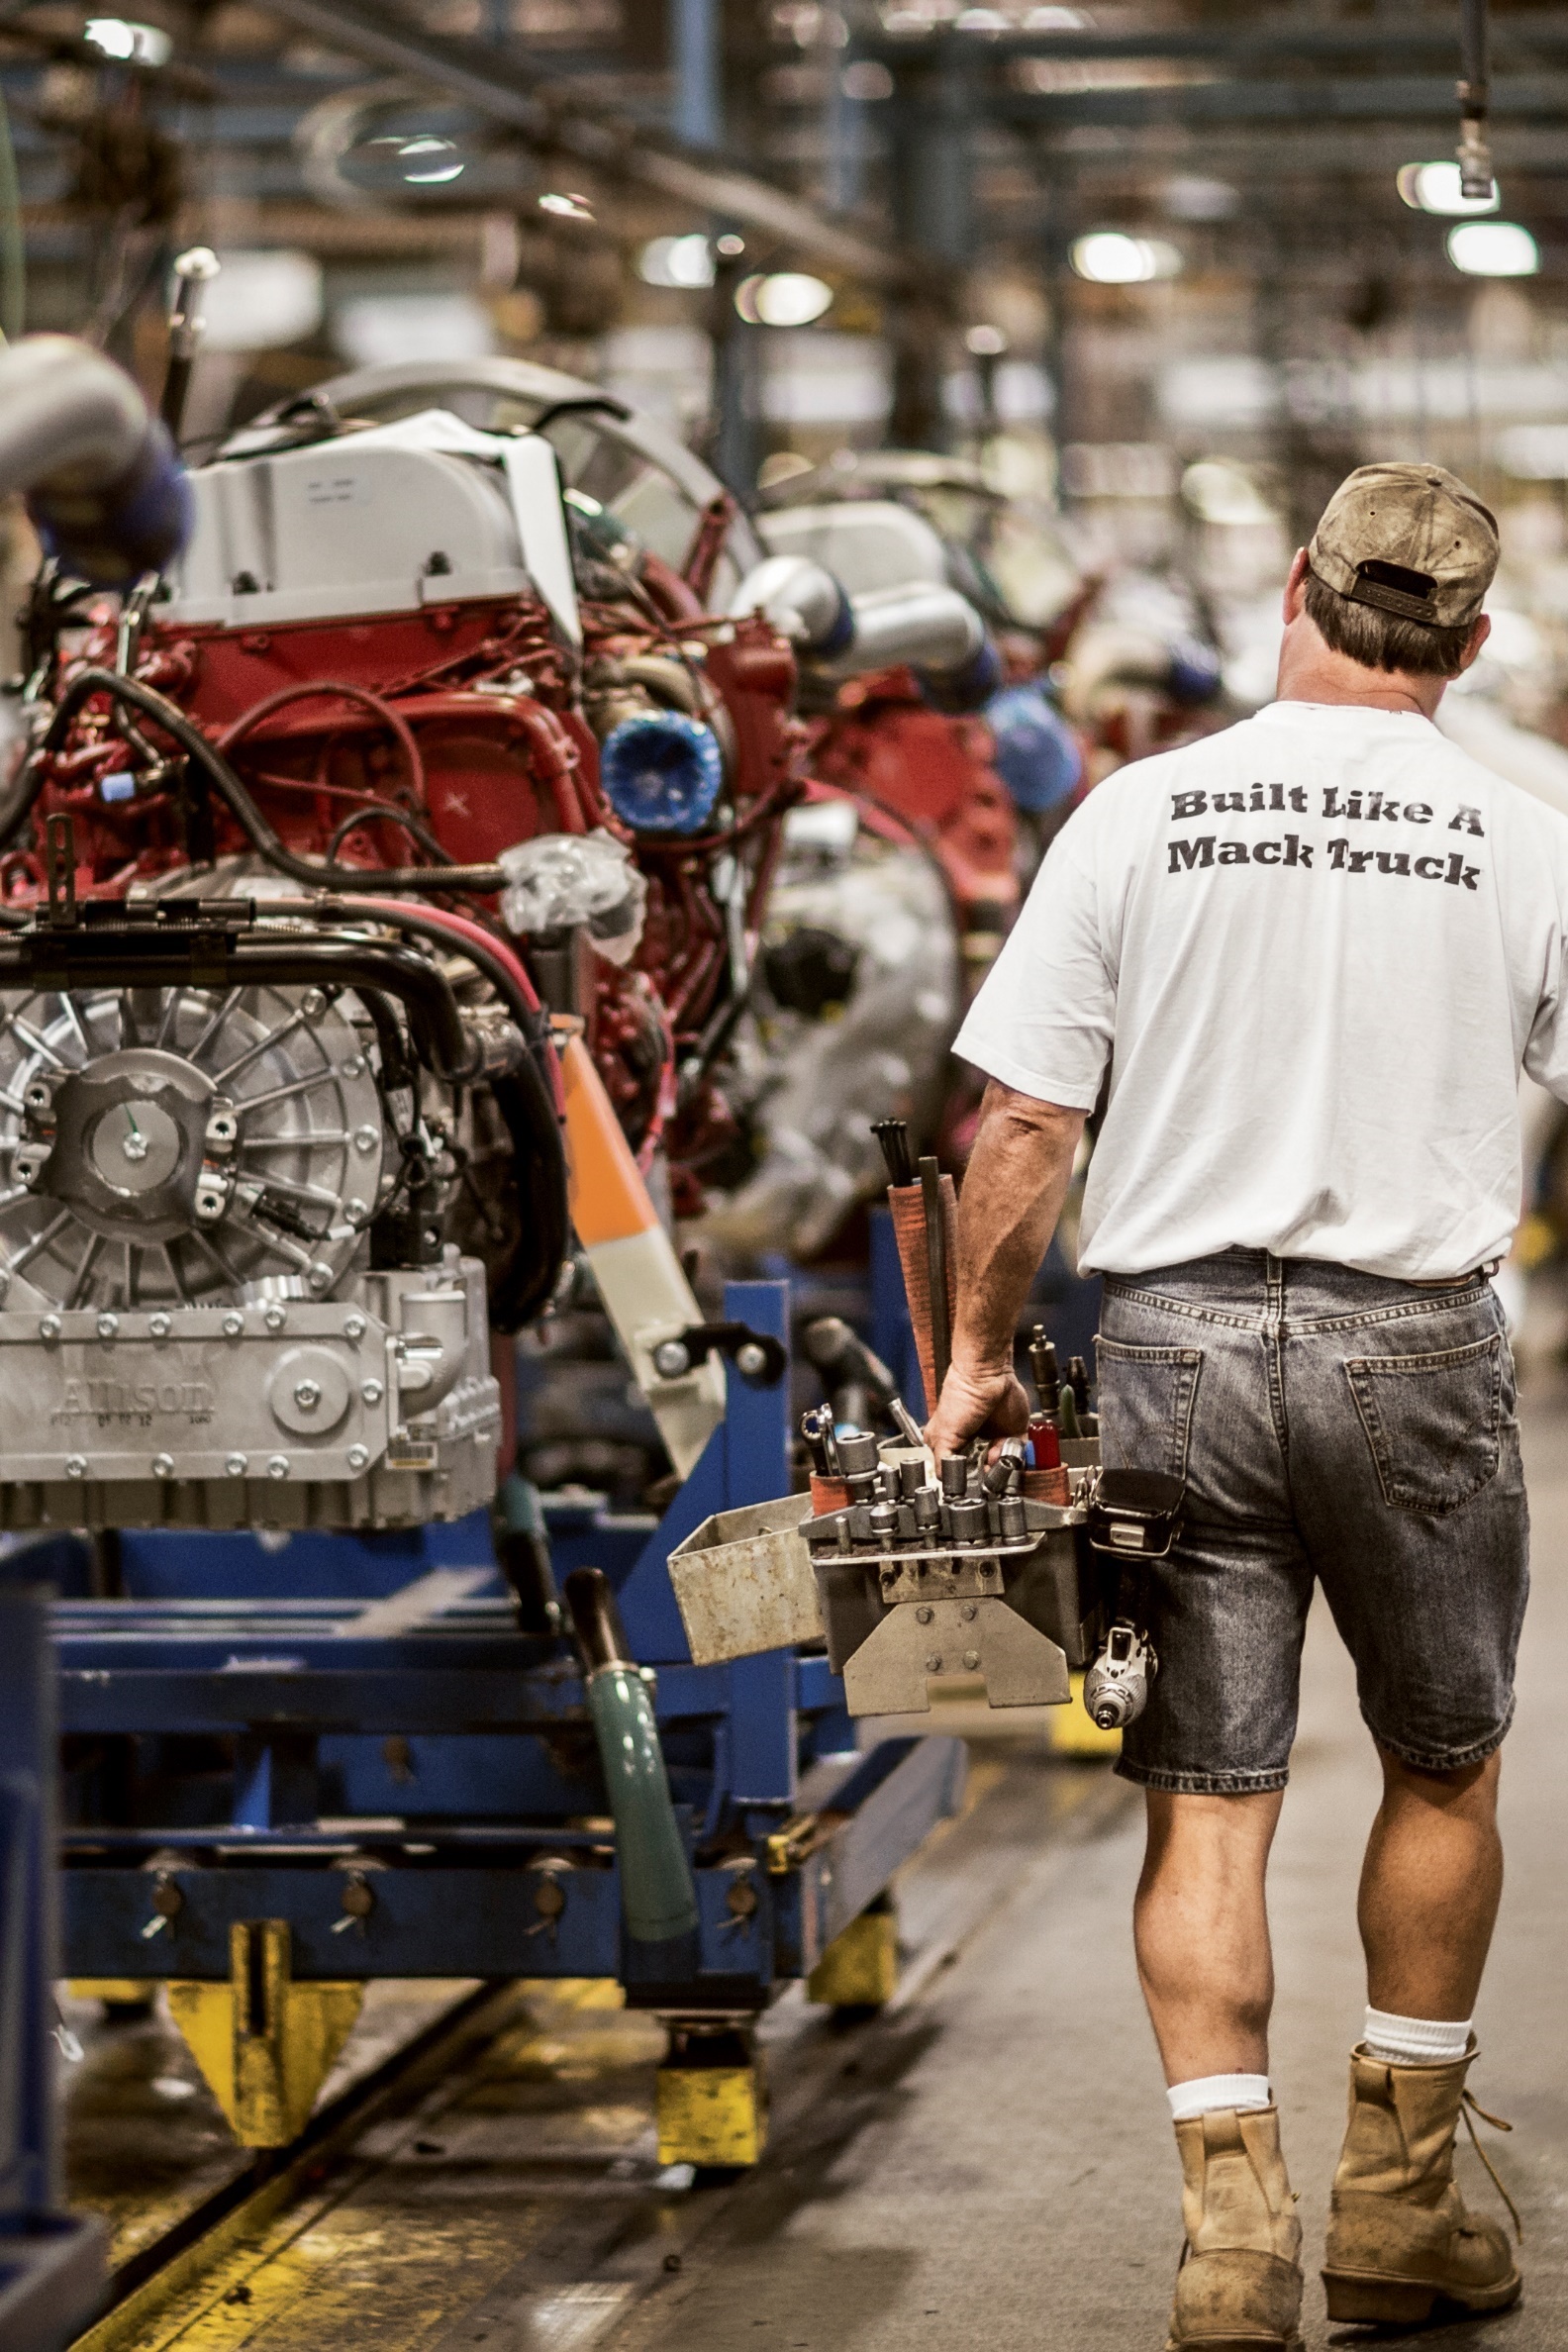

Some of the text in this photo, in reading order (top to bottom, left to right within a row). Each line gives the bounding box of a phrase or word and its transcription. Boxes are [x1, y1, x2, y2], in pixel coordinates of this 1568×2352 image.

[1171, 782, 1485, 837] Built Like A
[1167, 833, 1481, 891] Mack Truck
